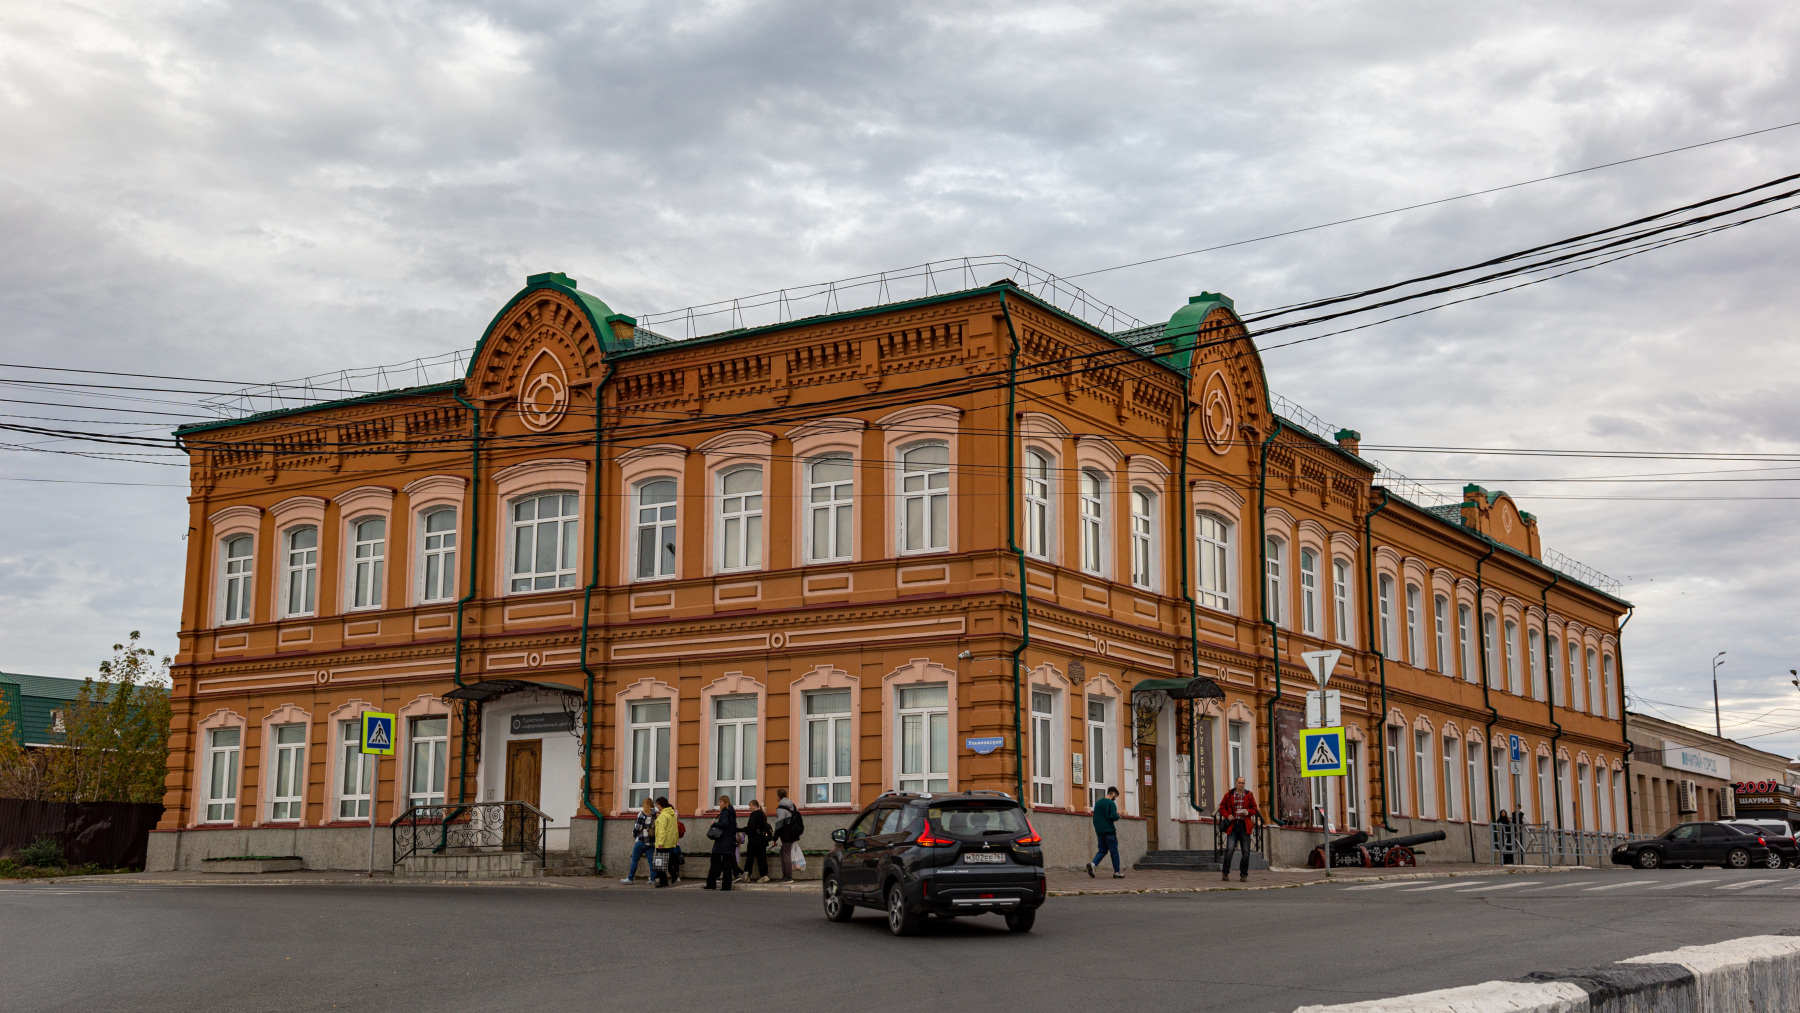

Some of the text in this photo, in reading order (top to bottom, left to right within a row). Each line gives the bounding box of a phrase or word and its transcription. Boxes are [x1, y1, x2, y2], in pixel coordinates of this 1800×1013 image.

[1199, 726, 1207, 807] СУВЕНИРЫ
[1687, 752, 1717, 773] ЧИТАЙ-ГОРОД
[1736, 781, 1777, 793] 2007
